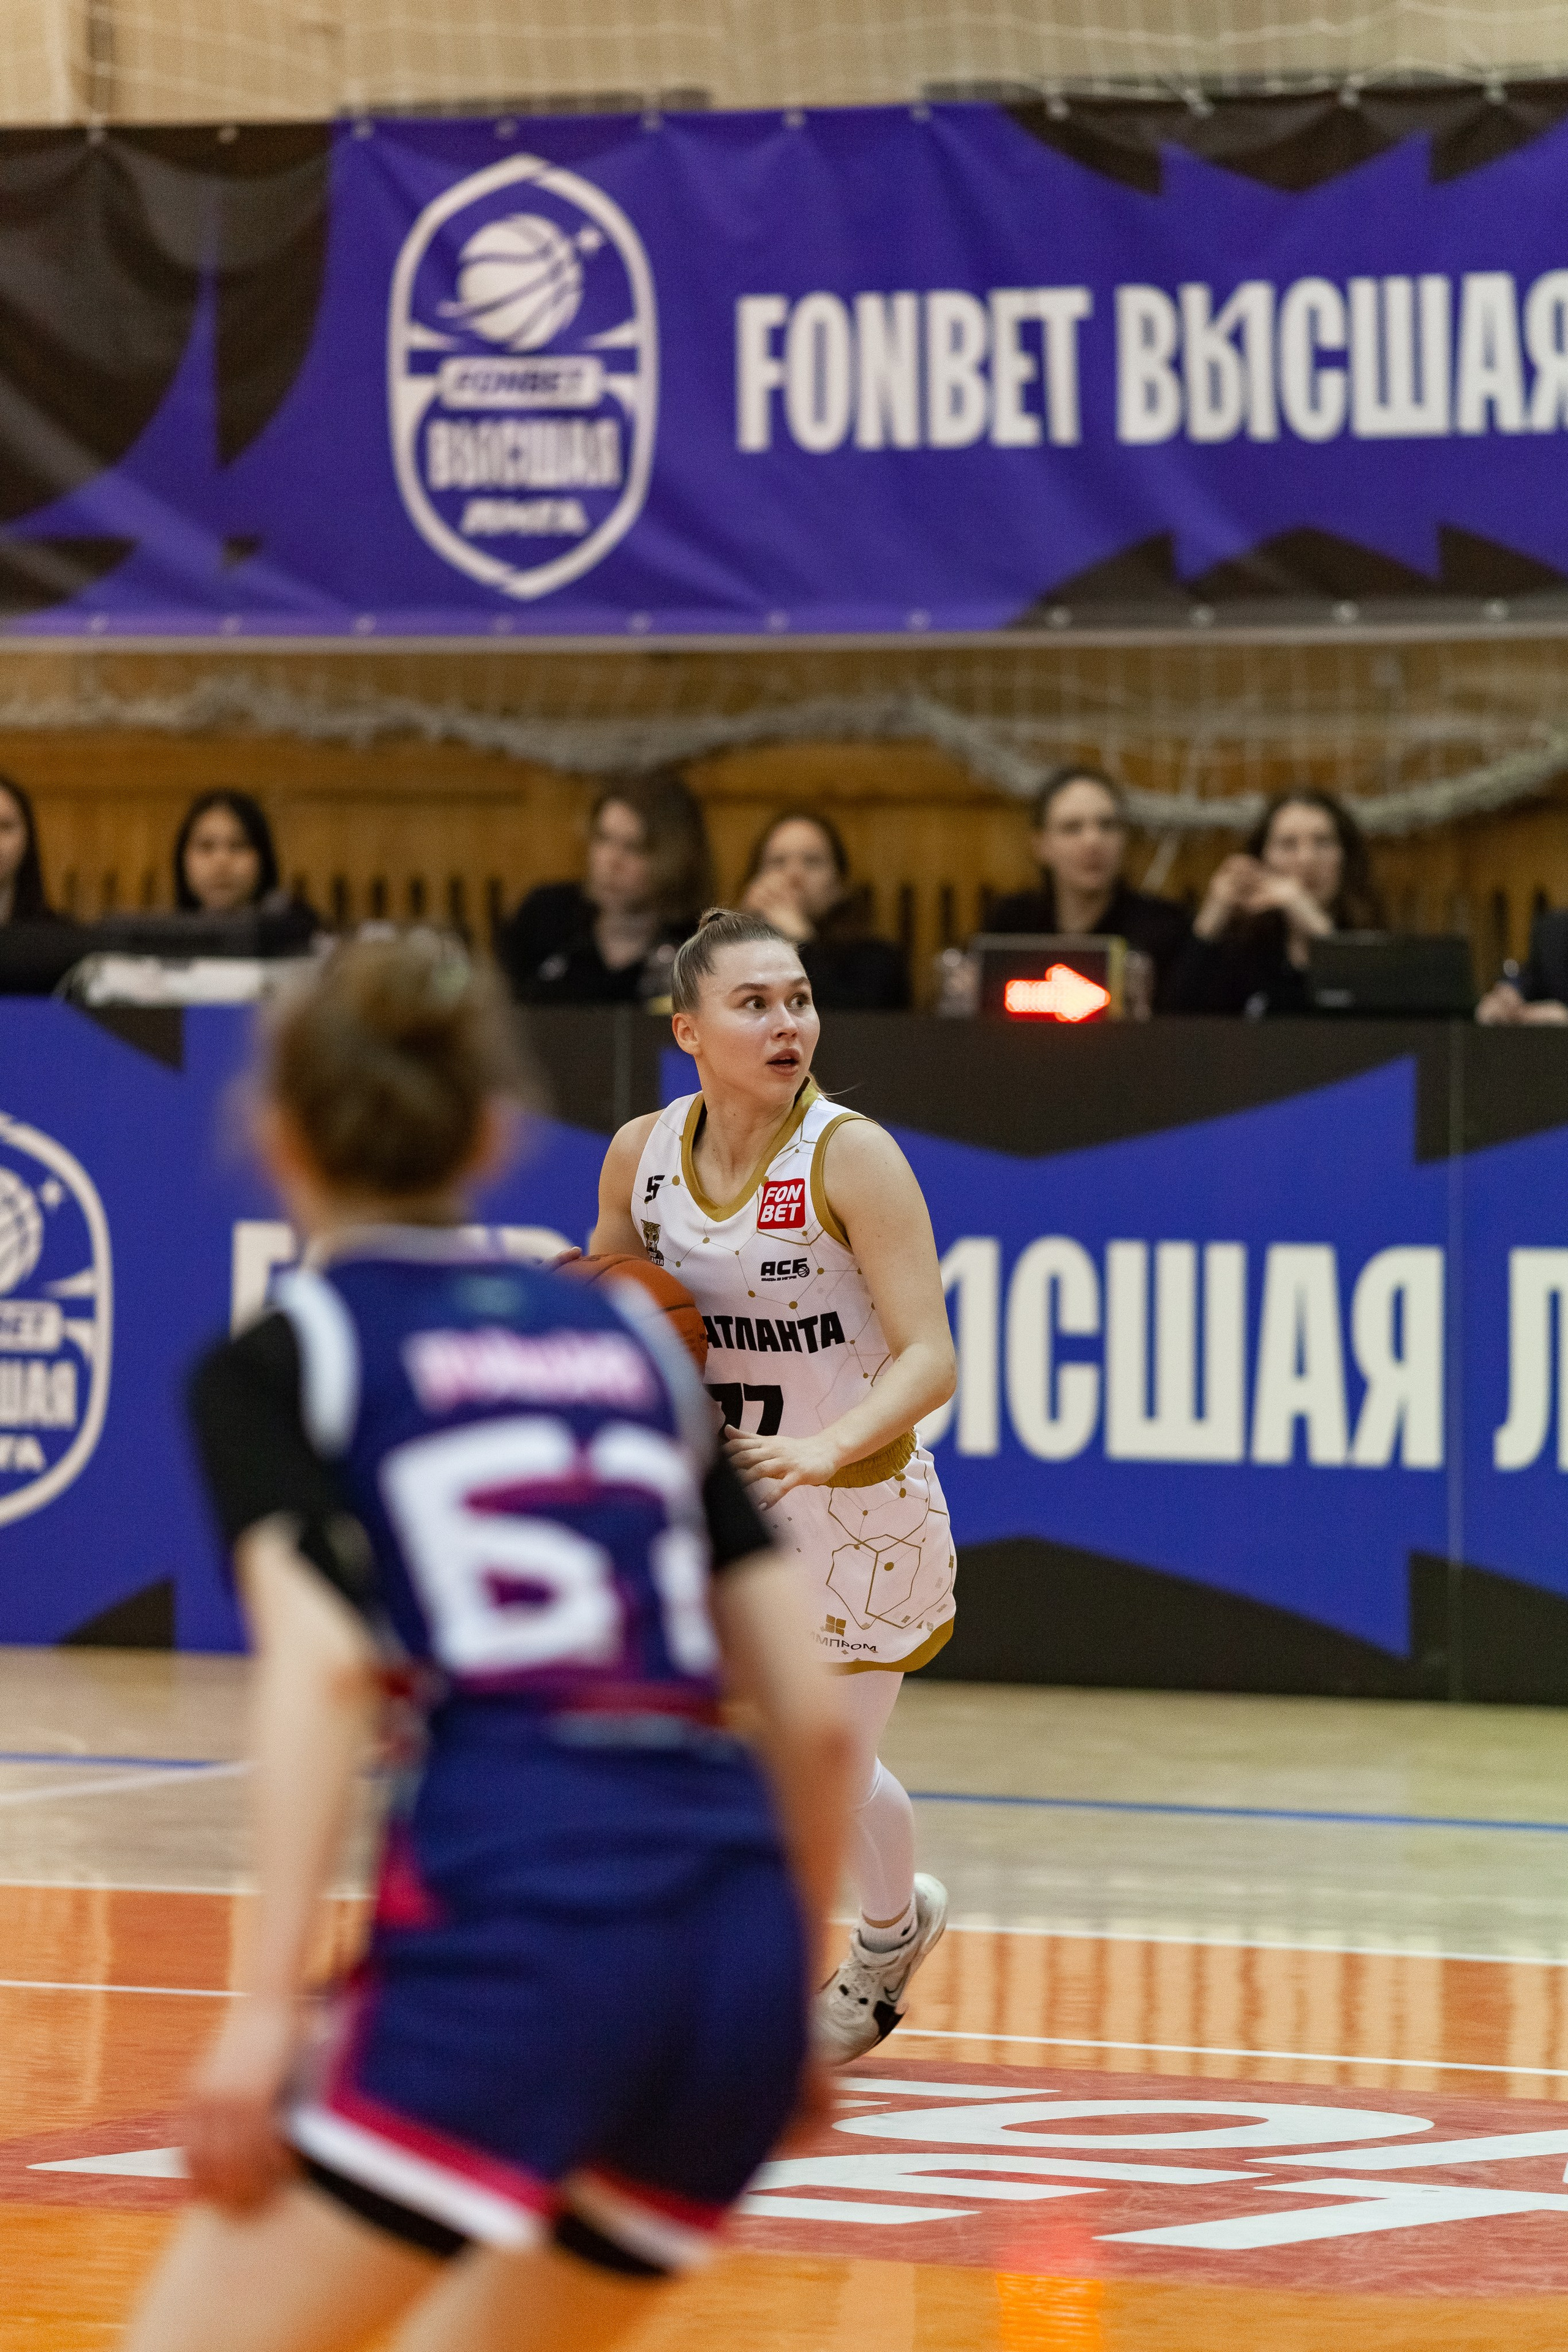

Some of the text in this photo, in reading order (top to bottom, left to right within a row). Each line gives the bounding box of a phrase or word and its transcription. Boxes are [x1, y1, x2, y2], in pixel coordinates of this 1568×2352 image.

[737, 285, 1093, 453] FONBET
[764, 1183, 803, 1204] FON
[760, 1203, 801, 1223] BET
